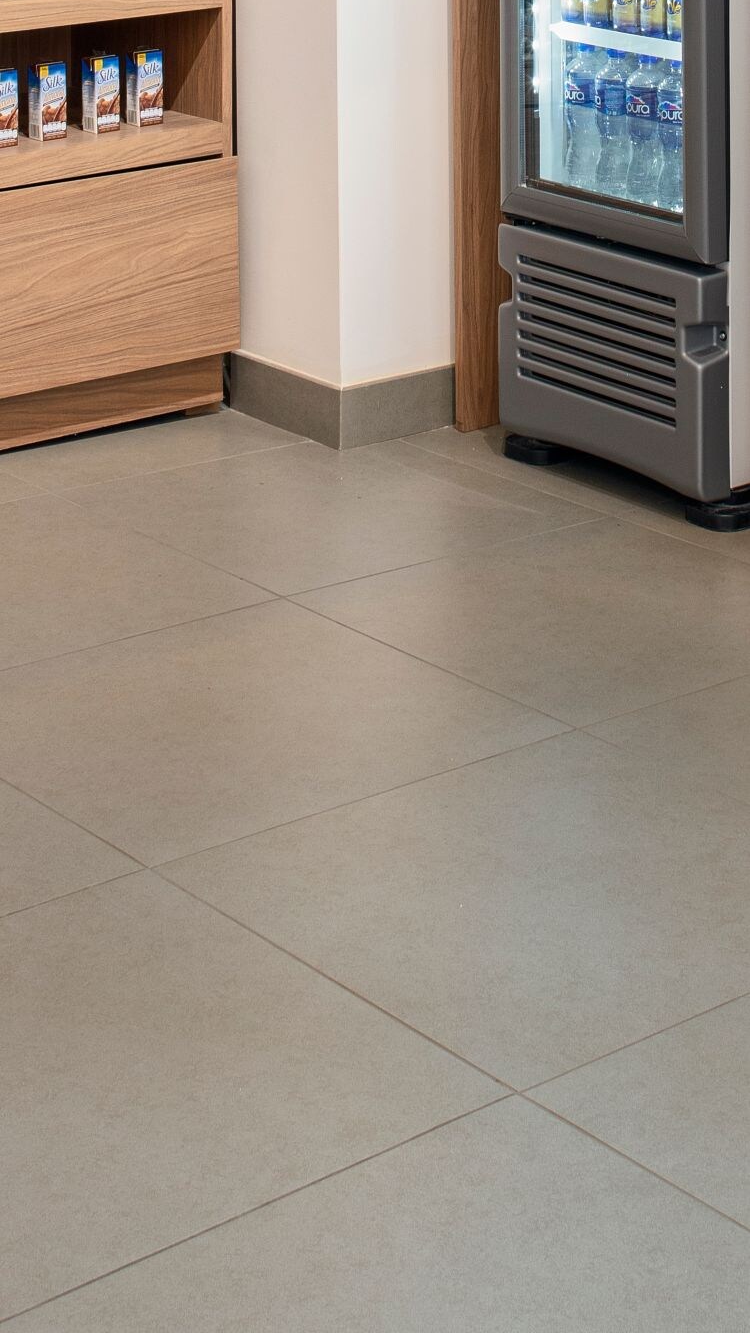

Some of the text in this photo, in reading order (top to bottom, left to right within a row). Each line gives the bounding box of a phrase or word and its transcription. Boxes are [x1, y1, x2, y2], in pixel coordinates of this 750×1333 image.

[98, 68, 116, 84] Silk
[141, 62, 159, 78] Silk
[0, 82, 15, 96] ilk
[43, 75, 63, 91] Silk
